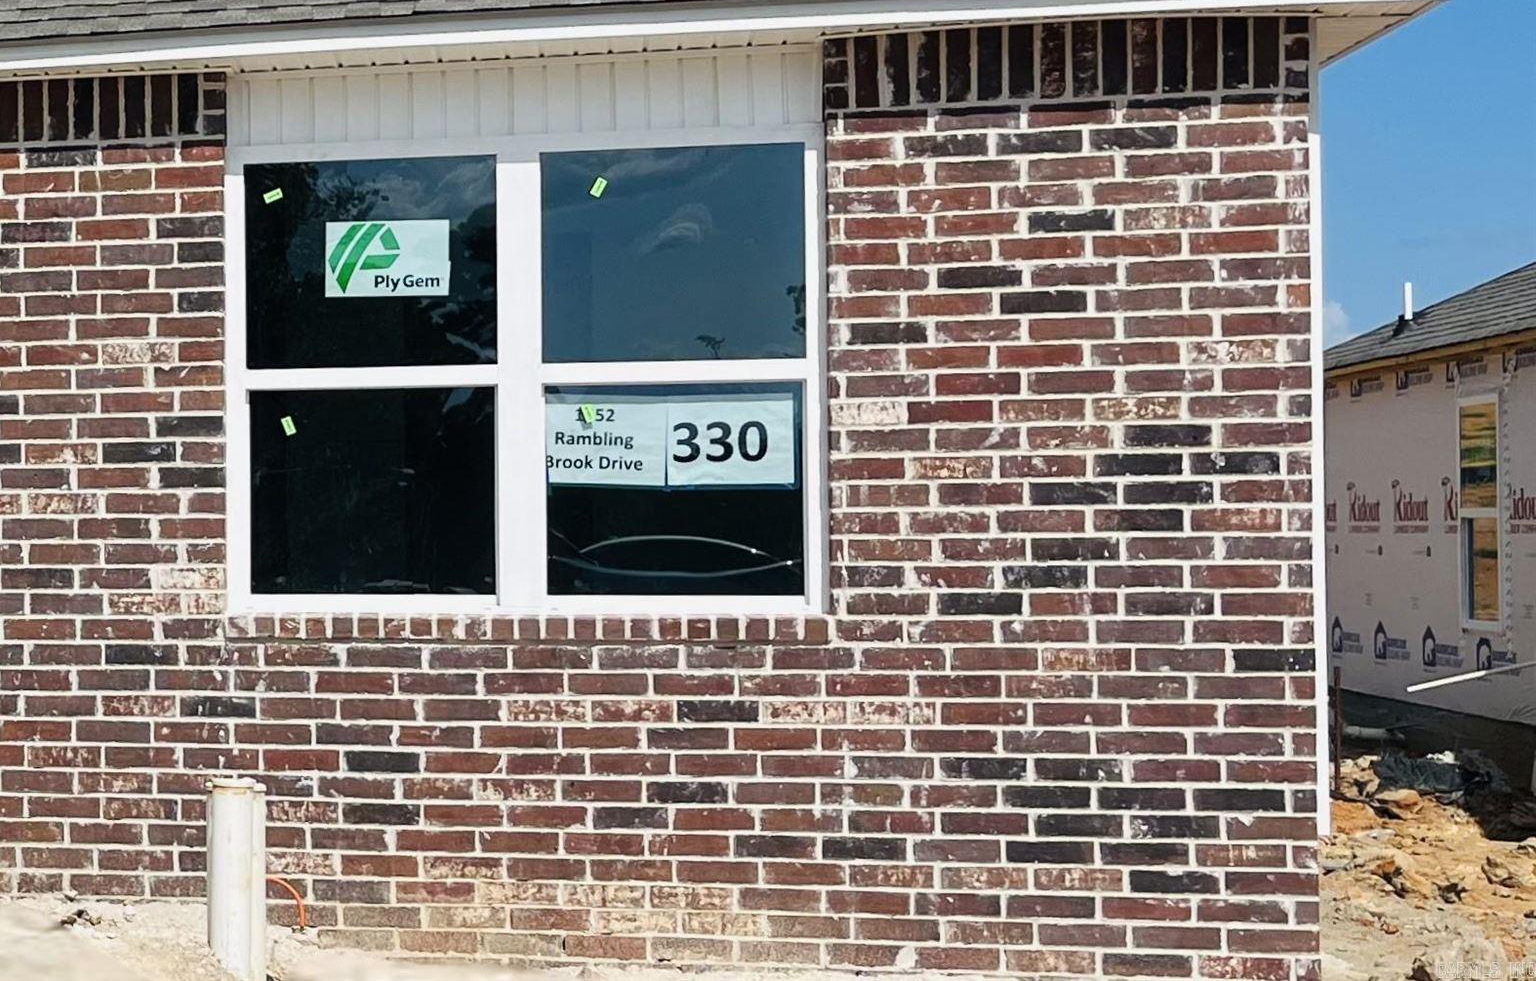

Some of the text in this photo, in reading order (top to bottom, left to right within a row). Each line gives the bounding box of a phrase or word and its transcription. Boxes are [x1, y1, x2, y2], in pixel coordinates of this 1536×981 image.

[374, 274, 440, 293] Ply Gem
[575, 406, 615, 422] 152
[555, 431, 634, 450] Rambling
[672, 420, 768, 463] 330
[546, 455, 643, 471] Brook Drive
